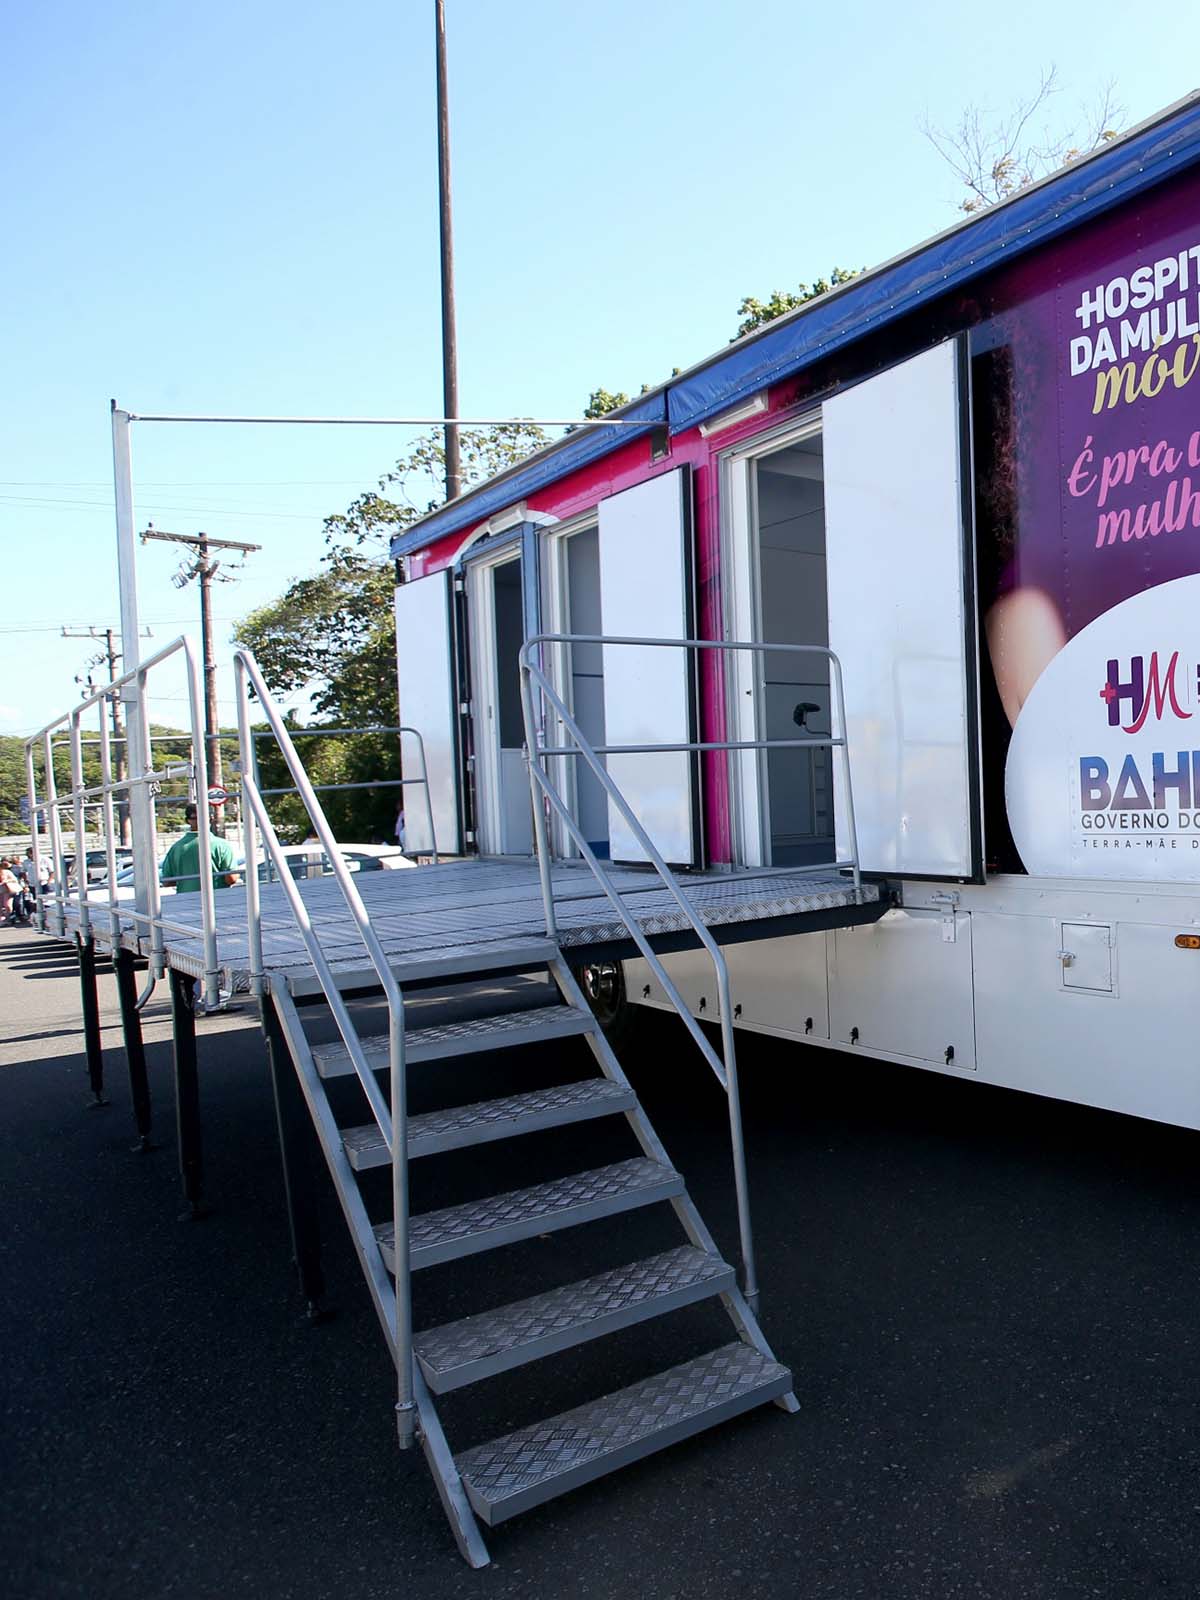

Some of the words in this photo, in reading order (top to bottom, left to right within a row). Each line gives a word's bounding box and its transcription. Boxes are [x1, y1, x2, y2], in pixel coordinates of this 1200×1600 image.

[1070, 327, 1117, 376] DA
[1067, 436, 1098, 497] É
[1097, 440, 1183, 507] pra
[1081, 812, 1169, 829] GOVERNO
[1082, 837, 1177, 849] TERRA-MÃE
